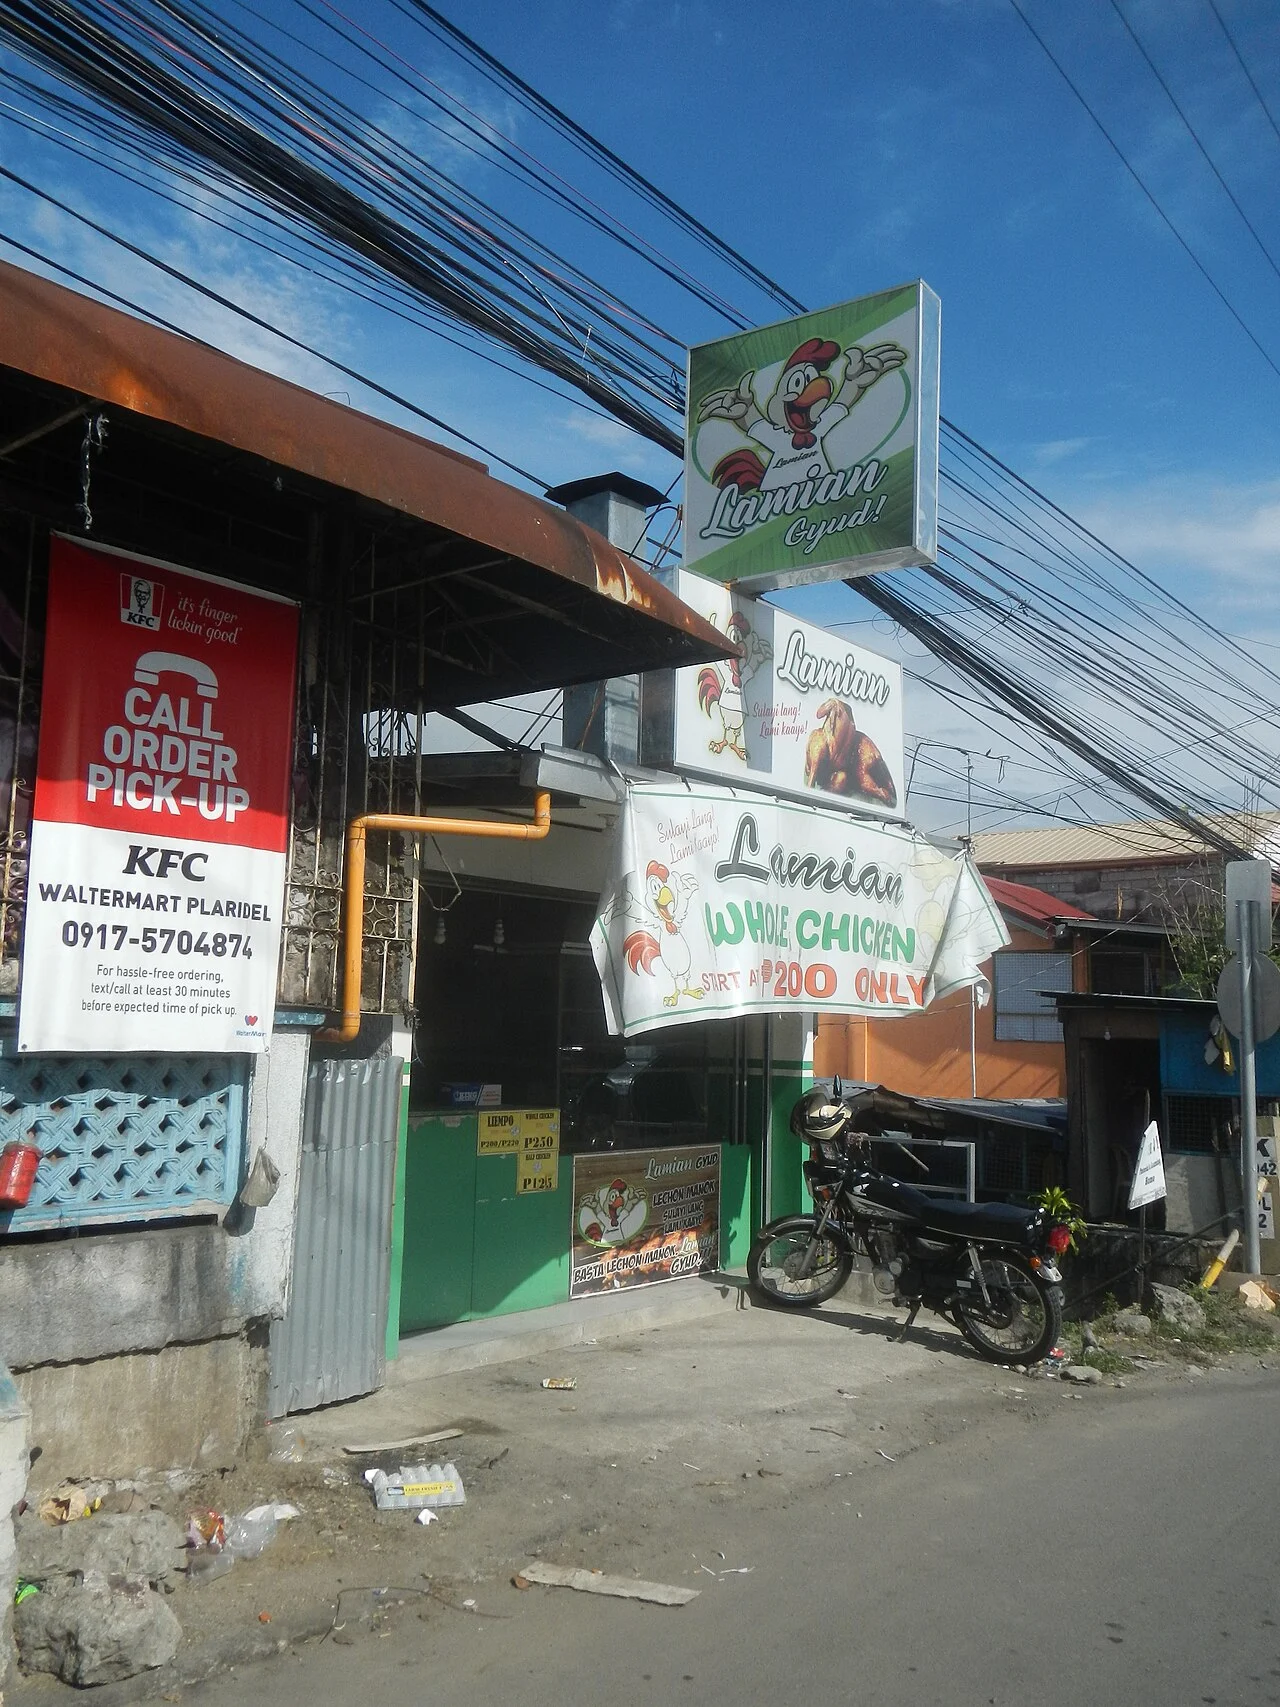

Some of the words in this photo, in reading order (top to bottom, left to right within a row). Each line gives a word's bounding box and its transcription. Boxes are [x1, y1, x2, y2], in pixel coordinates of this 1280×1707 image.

[701, 459, 888, 540] Lamian
[784, 495, 888, 554] Gyud!
[127, 612, 154, 628] KFC
[199, 598, 237, 626] finger
[777, 630, 891, 706] Lamian
[124, 687, 224, 741] CALL
[752, 702, 779, 724] Sulayi
[780, 702, 802, 723] lang!
[760, 721, 780, 739] Lami
[781, 720, 808, 742] kaayo!
[103, 725, 238, 784] ORDER
[87, 763, 250, 823] PICK-UP
[657, 818, 691, 843] Sulayi
[122, 845, 209, 882] KFC
[714, 812, 905, 911] Lamian
[38, 883, 182, 913] WALTERMART
[187, 897, 272, 922] PLARIDEL
[61, 920, 253, 960] 0917-5704874
[705, 900, 789, 948] WHOLE
[795, 909, 915, 963] CHICKEN
[97, 964, 114, 977] For
[117, 966, 175, 979] hassle-free
[177, 969, 224, 984] ordering,
[701, 970, 741, 991] START
[855, 967, 927, 1006] ONLY
[91, 982, 131, 995] text/call
[133, 985, 143, 995] at
[146, 985, 172, 996] least
[174, 986, 188, 997] 30
[190, 987, 231, 999] minutes
[81, 1000, 112, 1012] before
[114, 1002, 159, 1014] expected
[162, 1002, 186, 1014] time
[189, 1003, 199, 1014] of
[201, 1003, 222, 1016] pick
[224, 1007, 238, 1017] up.
[487, 1115, 514, 1127] LIEMPO
[524, 1136, 553, 1149] P250
[645, 1157, 692, 1180] Lamian
[695, 1152, 719, 1170] GYUD
[523, 1177, 552, 1190] P125
[652, 1186, 685, 1208] LECHON
[685, 1179, 716, 1201] MANOK
[573, 1263, 605, 1284] BASTA
[605, 1254, 643, 1274] LECHON
